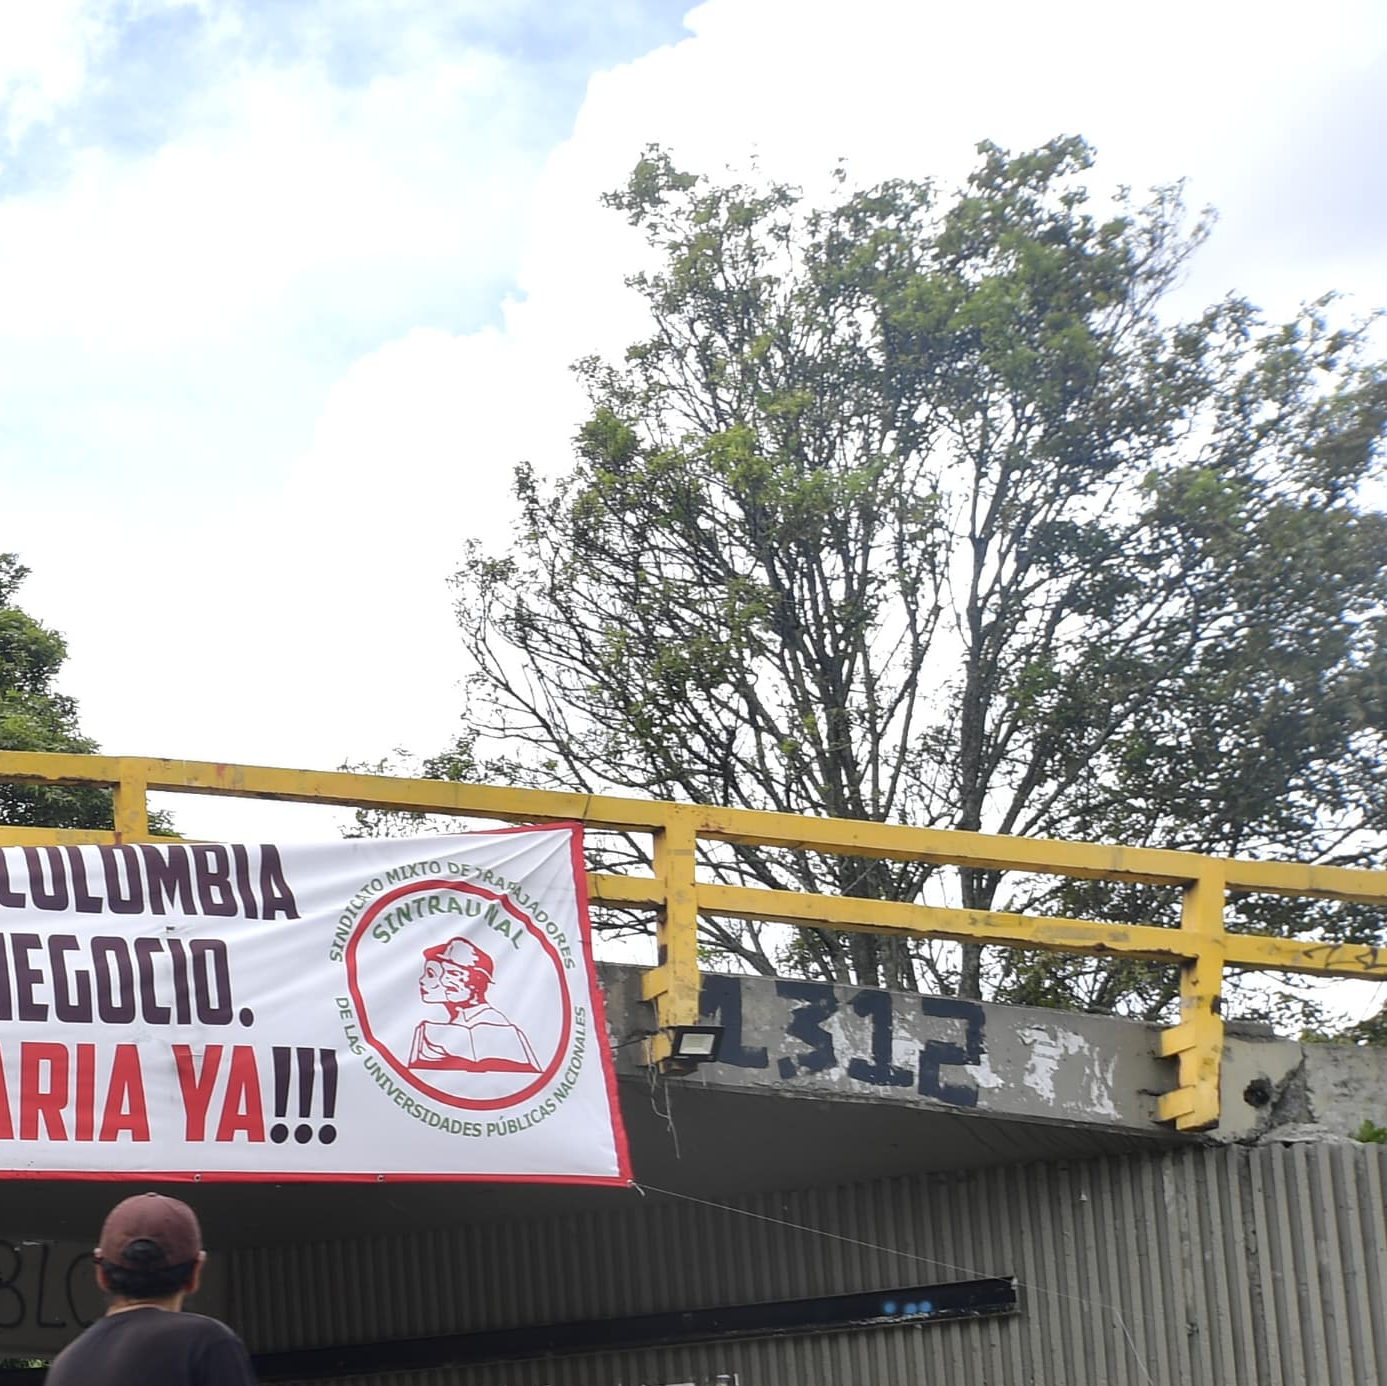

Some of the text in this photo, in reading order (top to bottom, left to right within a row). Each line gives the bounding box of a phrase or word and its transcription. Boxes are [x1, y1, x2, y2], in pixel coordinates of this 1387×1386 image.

[329, 878, 384, 963] SINDICATO
[385, 860, 442, 885] MIXTO
[447, 861, 471, 877] DE
[372, 895, 524, 950] SINTRAUNAL
[172, 1043, 339, 1146] YA!!!
[335, 996, 587, 1138] DE LAS UNIVERSIDADES PÚBLICAS NACIONALES
